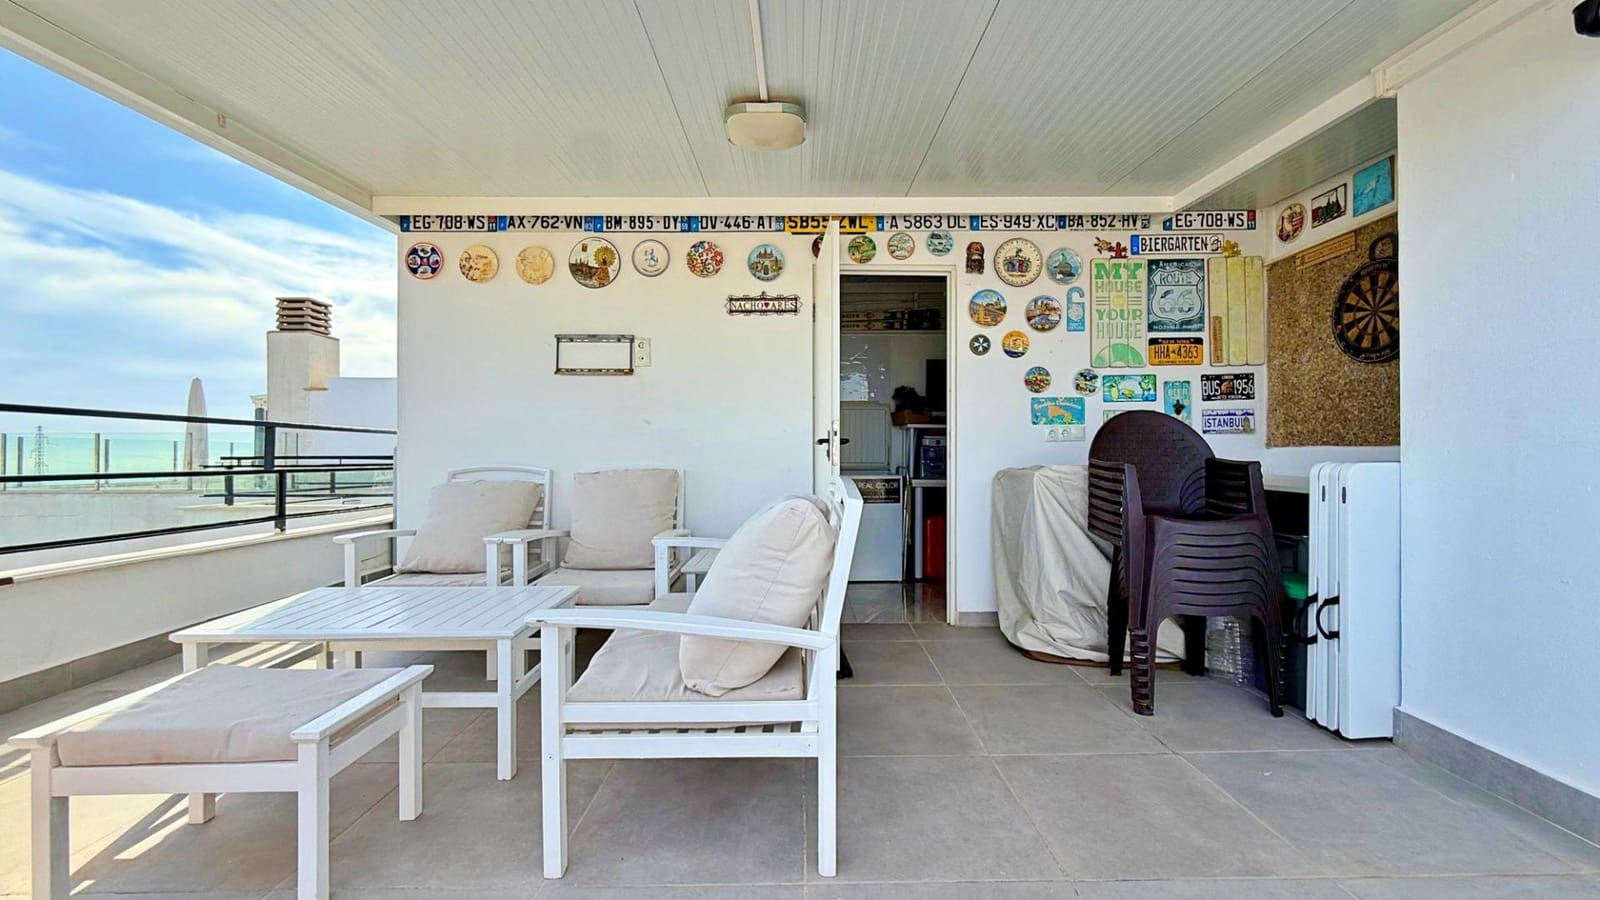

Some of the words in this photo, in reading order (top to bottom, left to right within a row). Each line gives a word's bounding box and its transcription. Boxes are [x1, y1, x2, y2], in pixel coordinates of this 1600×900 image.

[413, 215, 485, 230] EG-708-WS
[507, 215, 583, 229] AX-762-VN
[700, 215, 774, 230] DV-446-AT
[980, 215, 1055, 229] ES-949-XC
[1068, 215, 1138, 228] BA-852-HV
[1175, 212, 1245, 228] EG-708-WS
[1140, 236, 1208, 252] BIERGARTEN
[1094, 262, 1143, 280] MY
[1159, 271, 1193, 285] ROUTE
[1095, 281, 1143, 293] HOUSE
[1158, 288, 1196, 314] 66
[1095, 308, 1143, 321] YOUR
[1096, 322, 1143, 340] HOUSE
[1176, 344, 1199, 359] 4363
[1202, 380, 1221, 396] BUS
[1233, 378, 1255, 395] 1956
